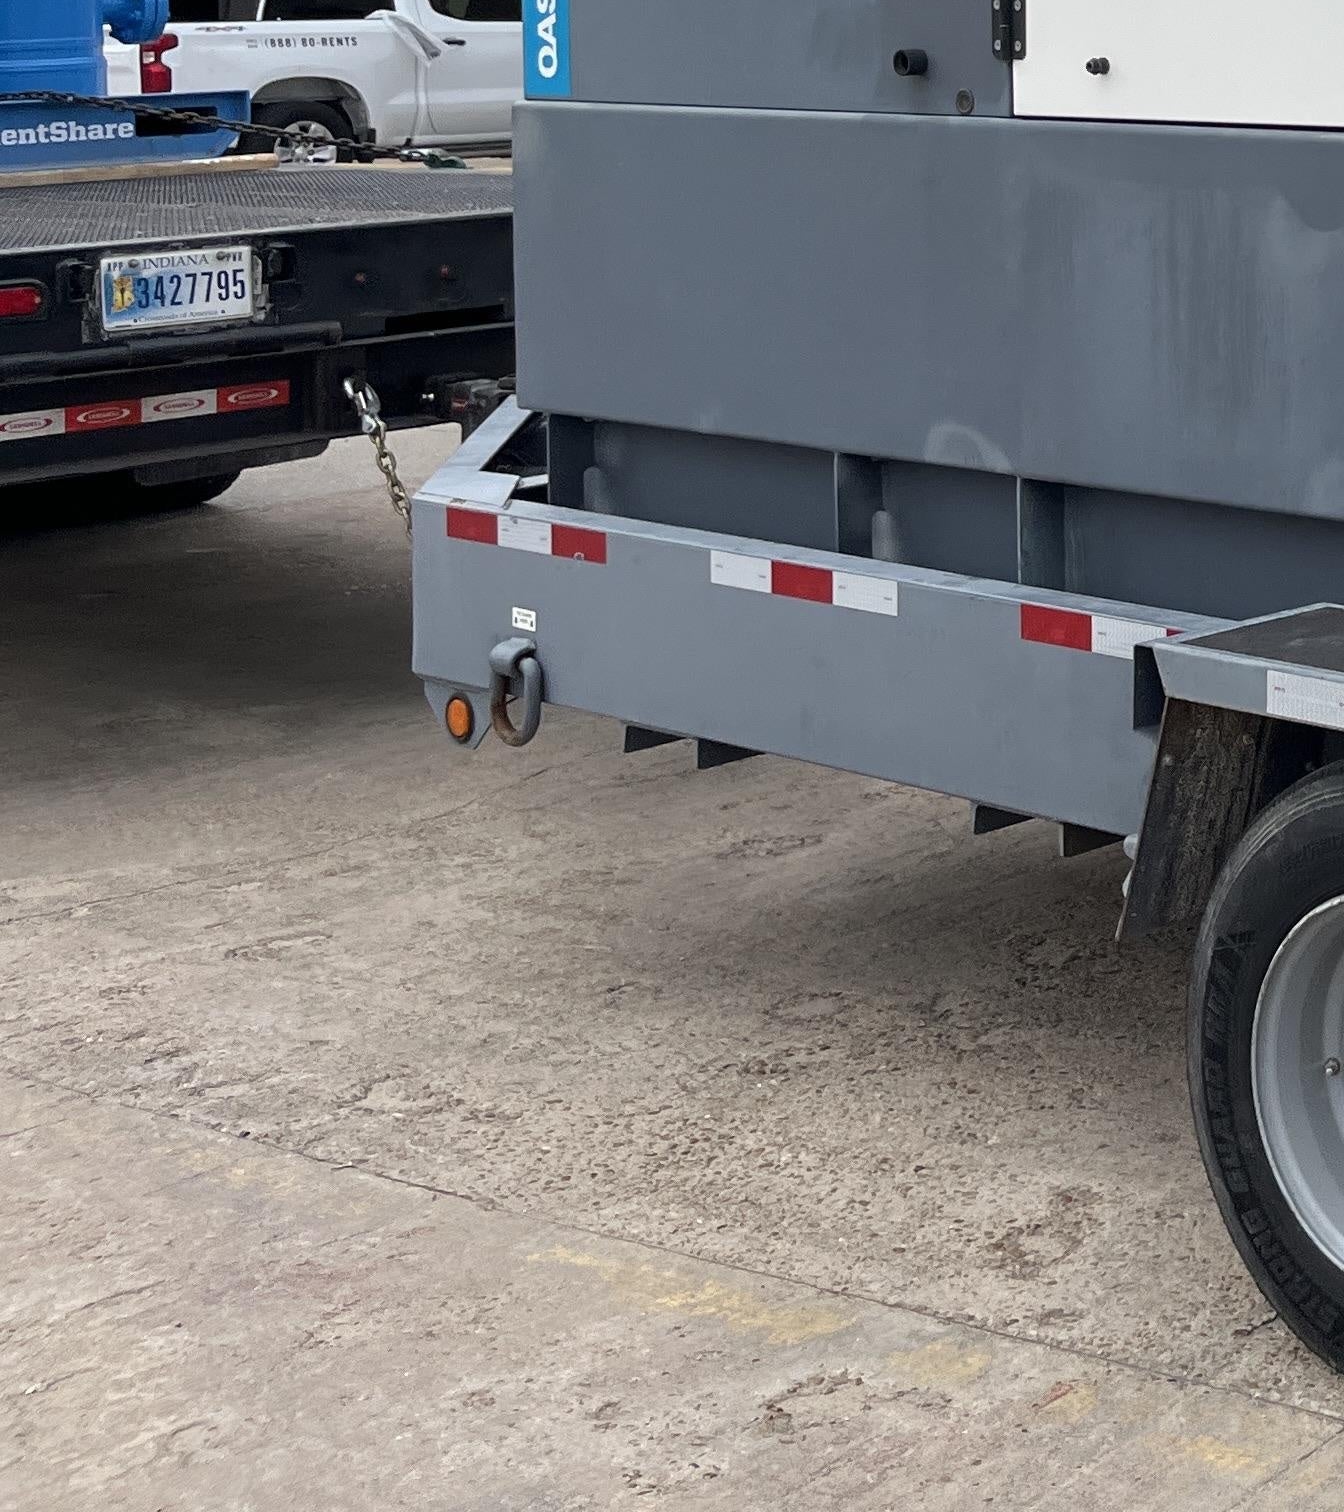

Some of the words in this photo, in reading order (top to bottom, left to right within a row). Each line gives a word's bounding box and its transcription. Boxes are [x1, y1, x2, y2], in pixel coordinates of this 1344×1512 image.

[264, 37, 297, 49] (888)
[301, 36, 358, 48] 80-RENTS
[0, 120, 135, 146] entShare
[142, 253, 210, 270] INDIANA
[136, 268, 247, 310] 3427795
